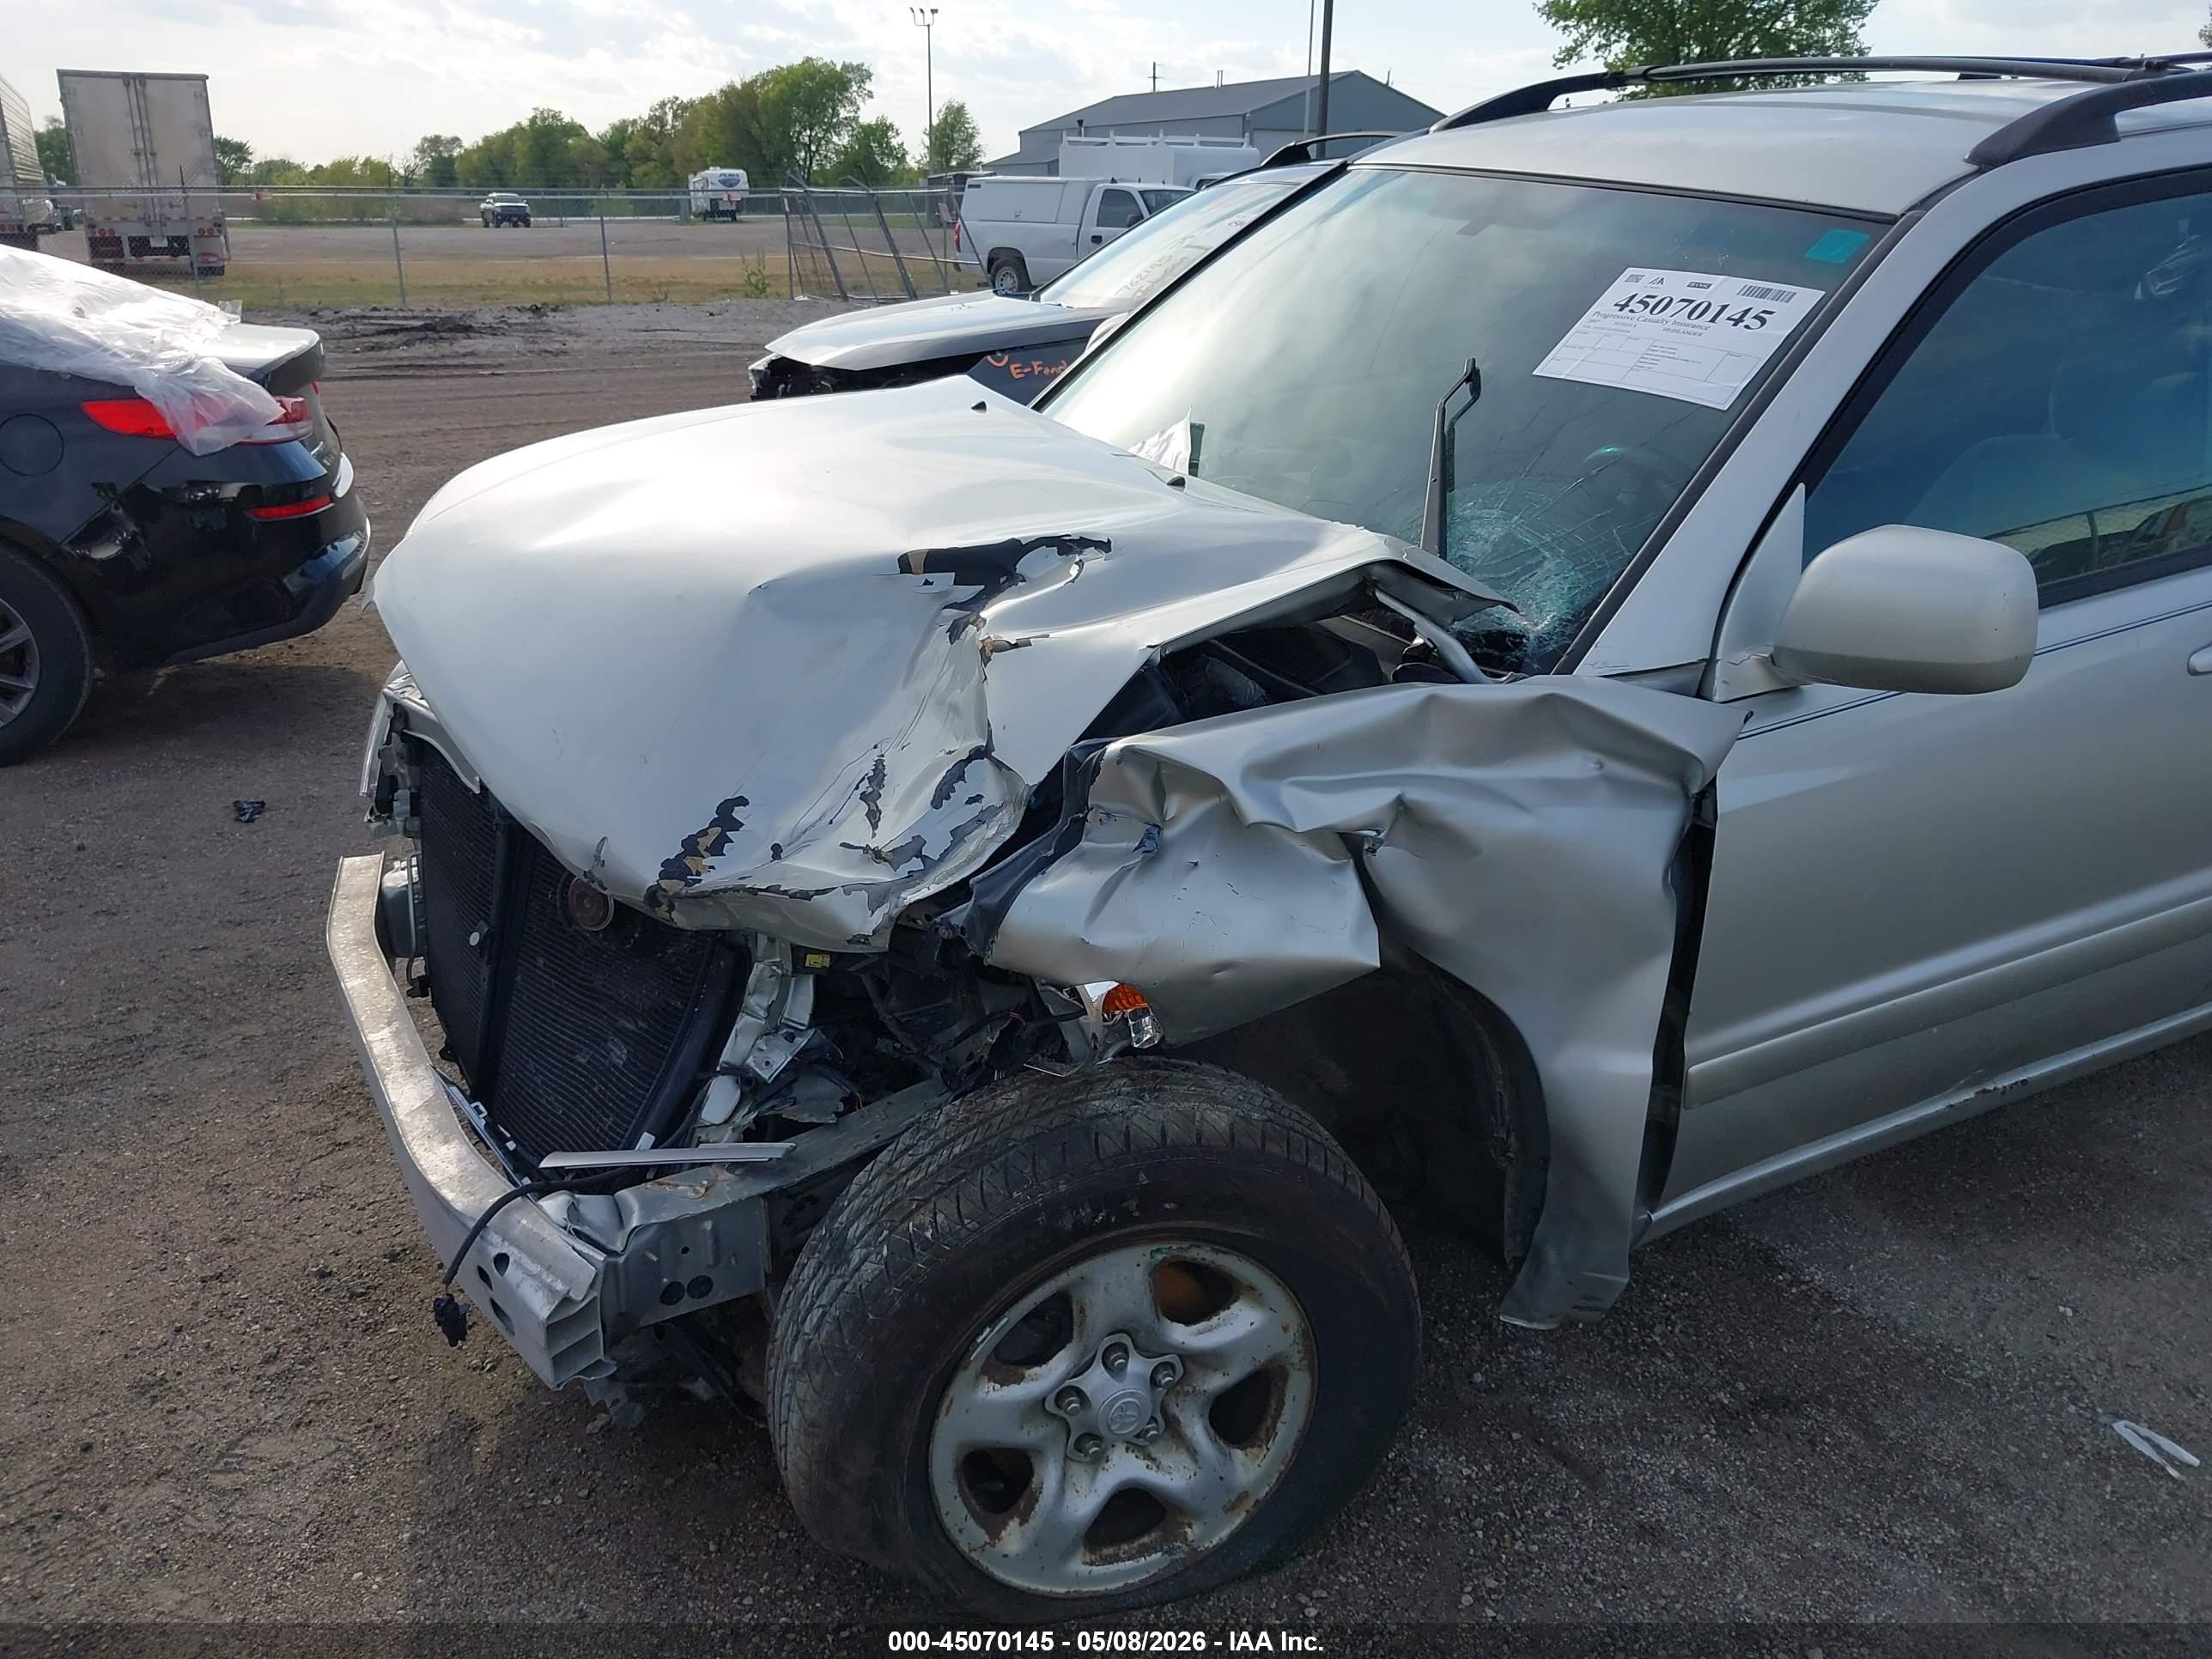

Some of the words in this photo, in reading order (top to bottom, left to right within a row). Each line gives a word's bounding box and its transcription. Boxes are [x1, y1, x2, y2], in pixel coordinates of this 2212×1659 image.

[1613, 293, 1777, 331] 45070145
[1636, 315, 1669, 326] Casualty
[1671, 319, 1711, 331] Insurance
